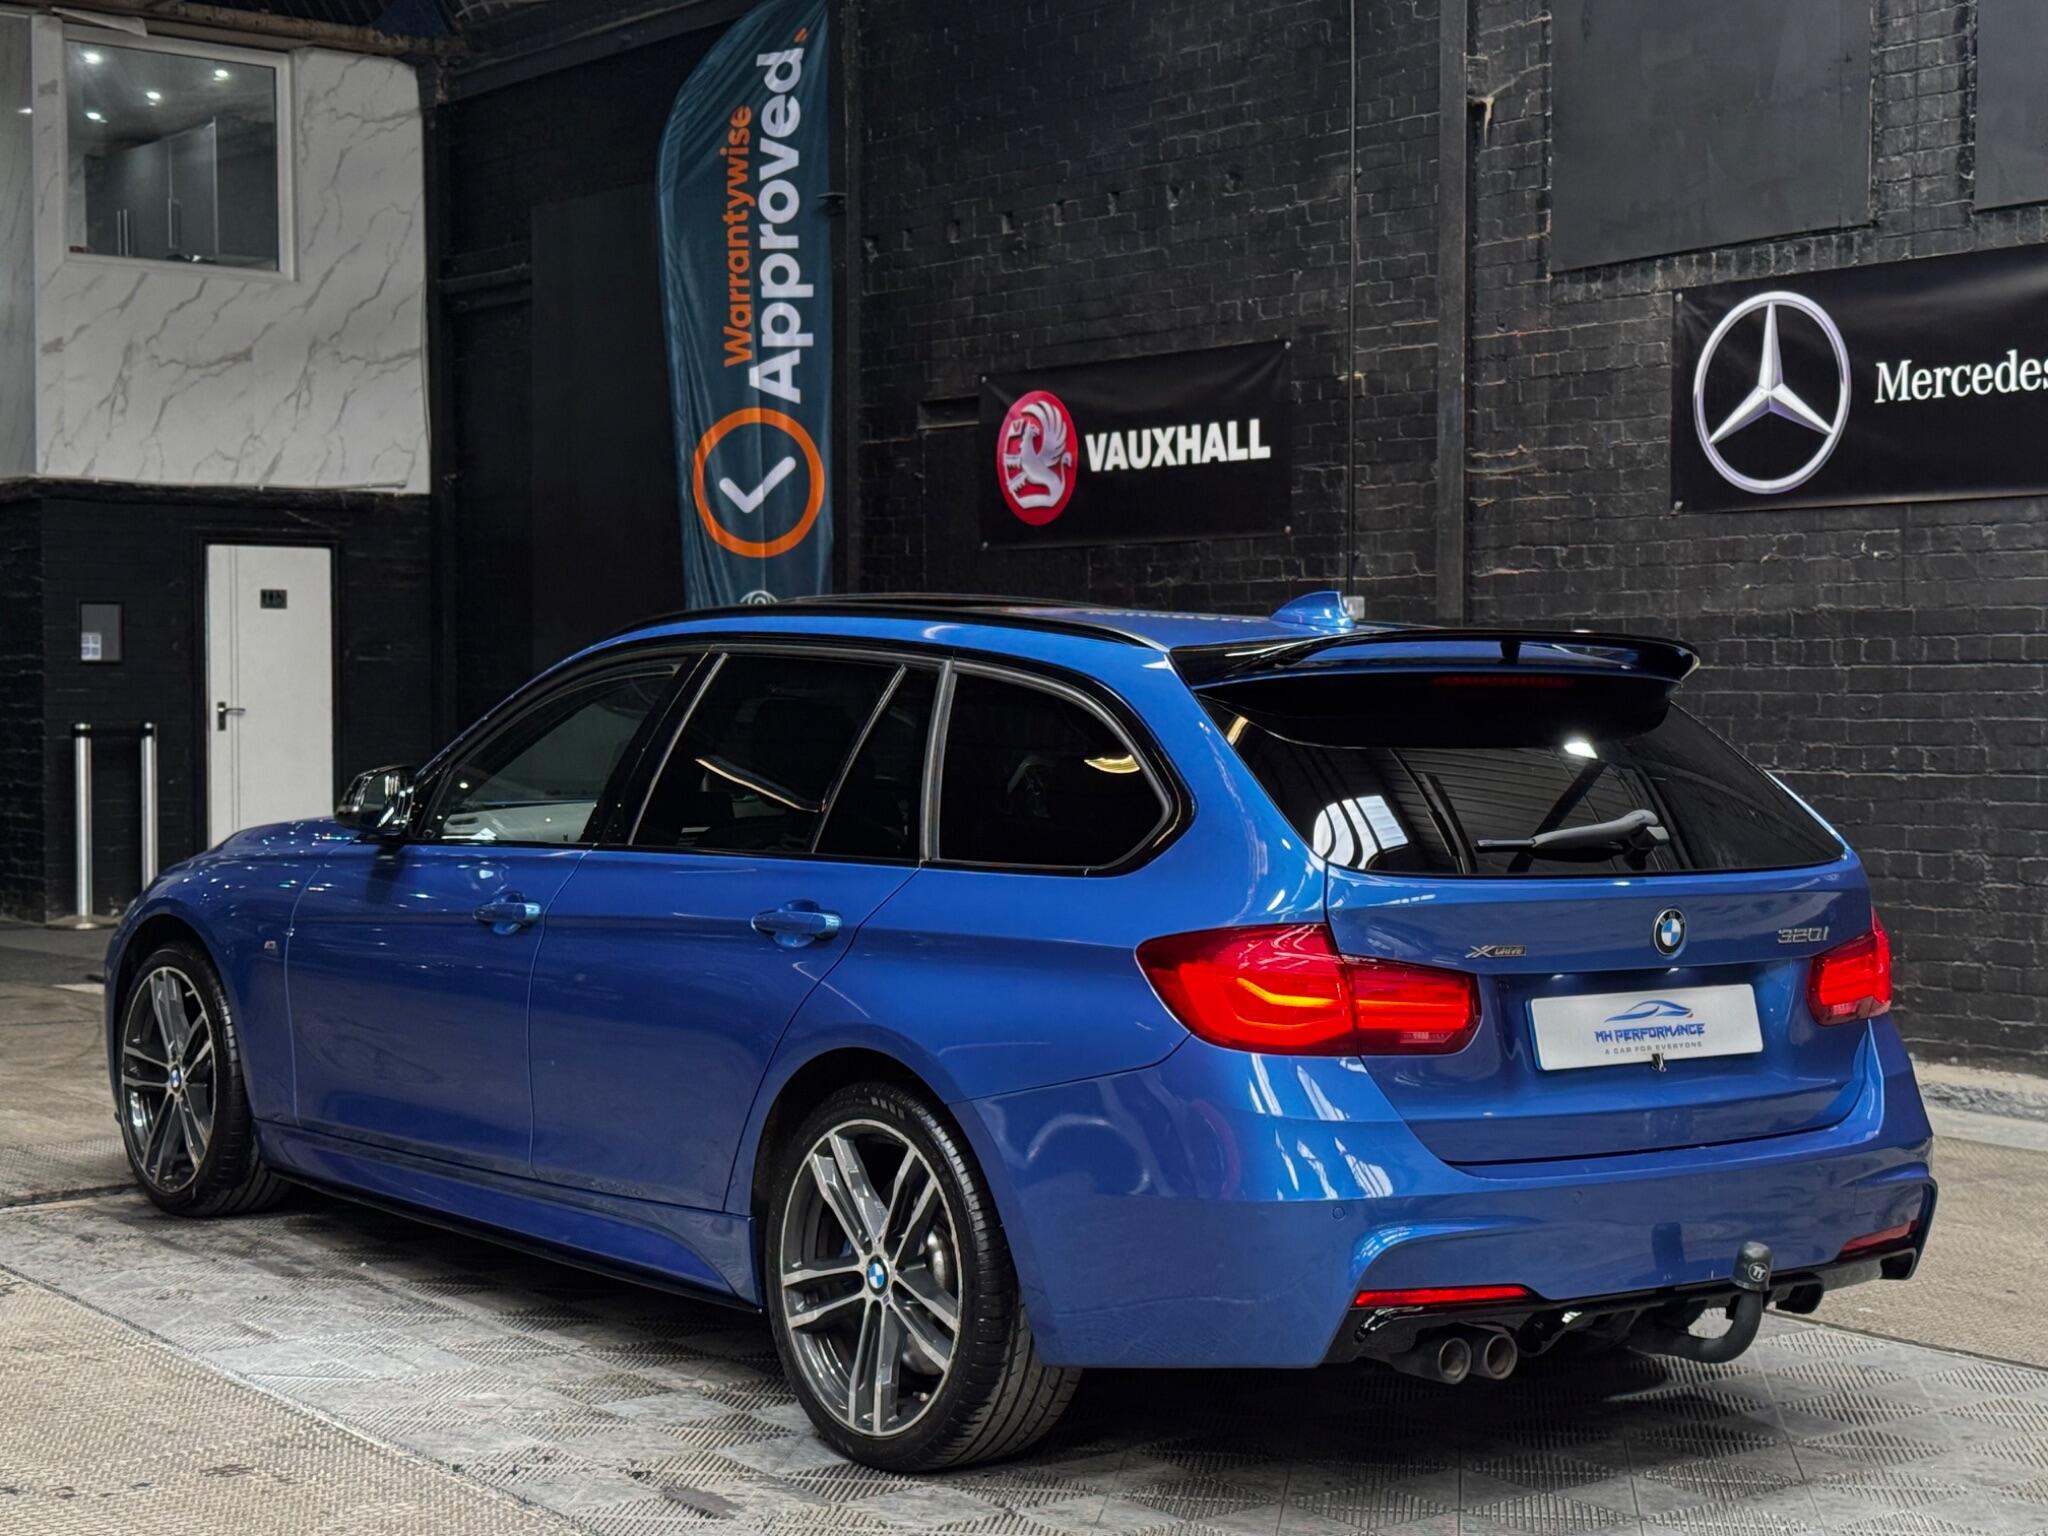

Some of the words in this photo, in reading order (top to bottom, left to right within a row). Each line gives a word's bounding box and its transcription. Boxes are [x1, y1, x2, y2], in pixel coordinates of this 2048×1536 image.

[720, 105, 755, 367] Warrantywise
[1874, 349, 2048, 403] Mercede
[1085, 418, 1271, 472] VAUXHALL
[1594, 1031, 1613, 1043] MH
[1614, 1023, 1705, 1042] PERFORMANCE
[1613, 1046, 1632, 1054] CAR
[1655, 1041, 1703, 1052] EVERYONE
